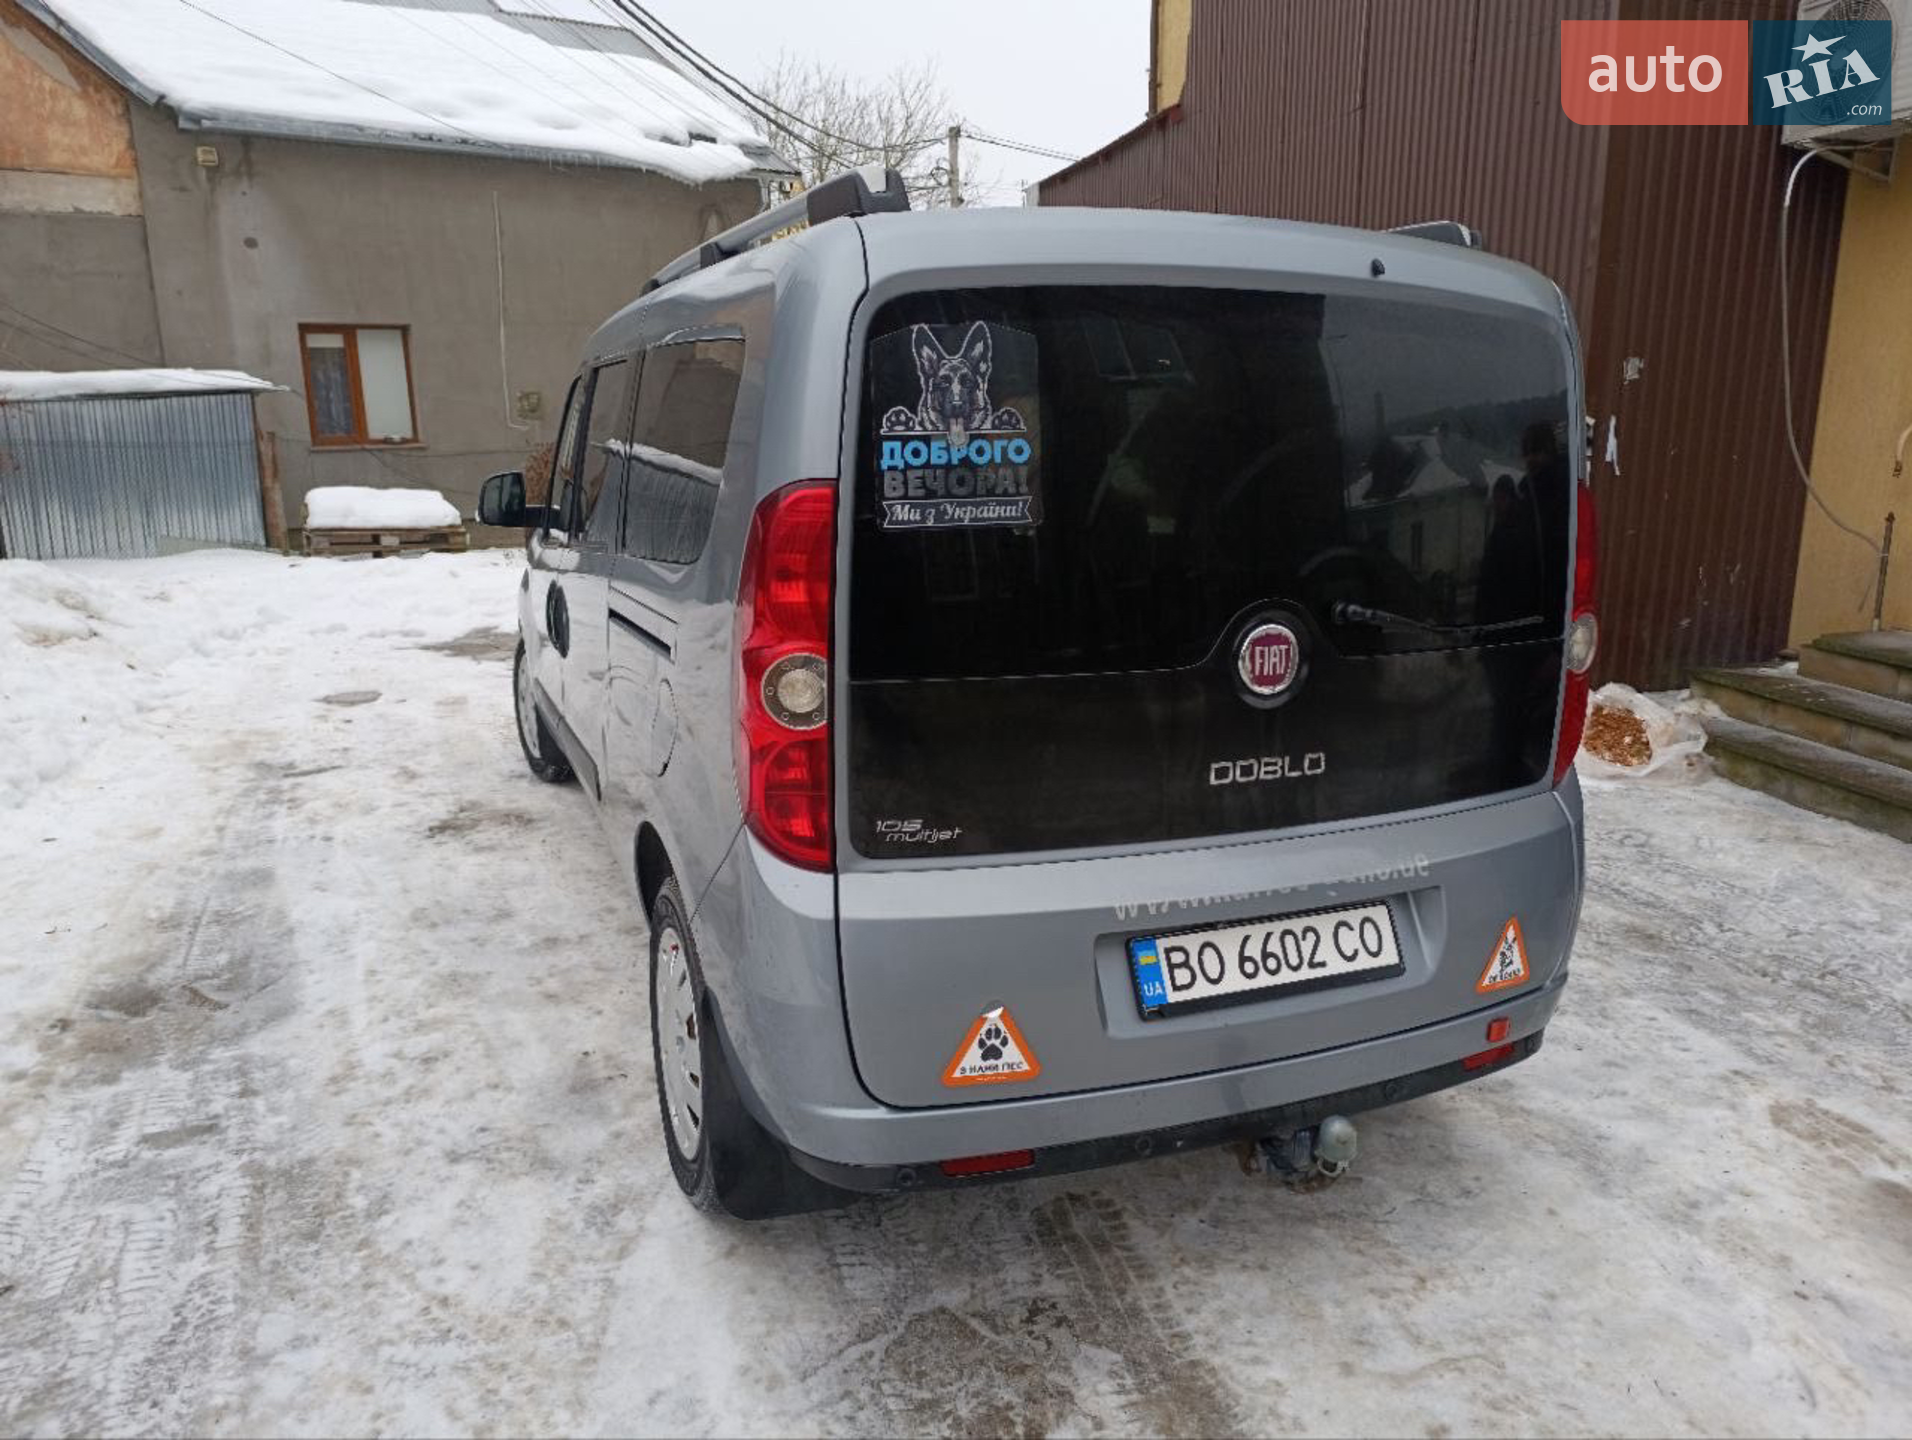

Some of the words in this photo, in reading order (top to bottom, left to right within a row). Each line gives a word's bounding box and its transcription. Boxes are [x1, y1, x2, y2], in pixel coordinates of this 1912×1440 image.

[881, 438, 1031, 470] ДОБРОГО
[883, 465, 1029, 498] ВЕЧОРА!
[892, 504, 921, 521] Ми
[940, 501, 1022, 523] України!
[1255, 645, 1288, 676] FIAT
[1209, 752, 1326, 785] DOBLO
[876, 819, 923, 833] 105
[1163, 941, 1225, 992] BO
[1237, 925, 1327, 979] 6602
[1333, 916, 1383, 963] CO
[1144, 983, 1163, 997] UA
